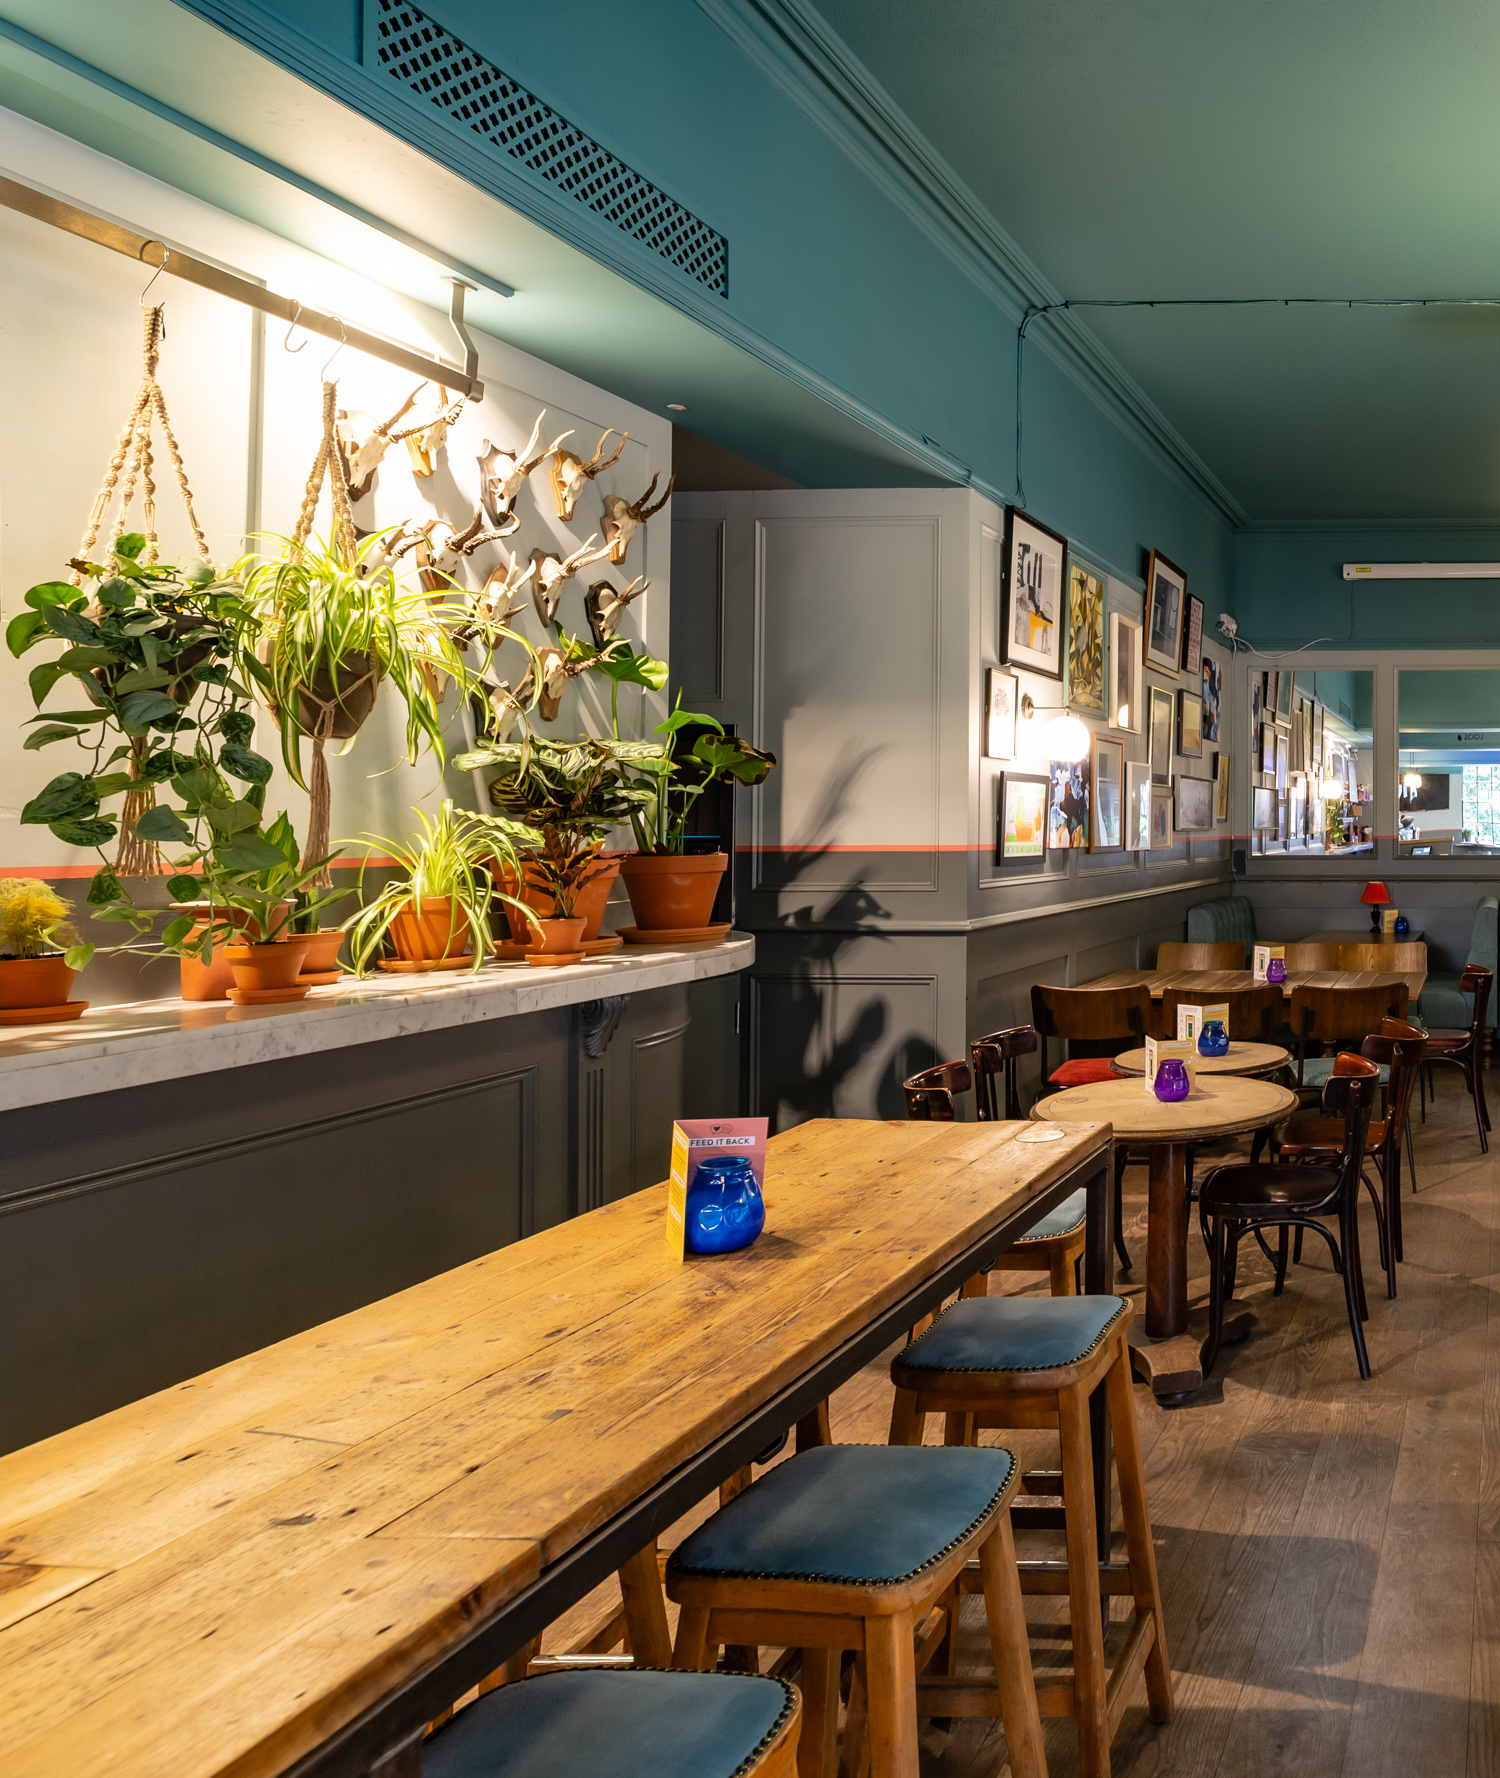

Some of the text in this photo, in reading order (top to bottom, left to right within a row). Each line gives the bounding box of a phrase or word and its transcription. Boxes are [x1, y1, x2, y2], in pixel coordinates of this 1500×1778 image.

[690, 1139, 714, 1147] FEED
[715, 1138, 724, 1146] IT
[726, 1137, 750, 1145] BACK
